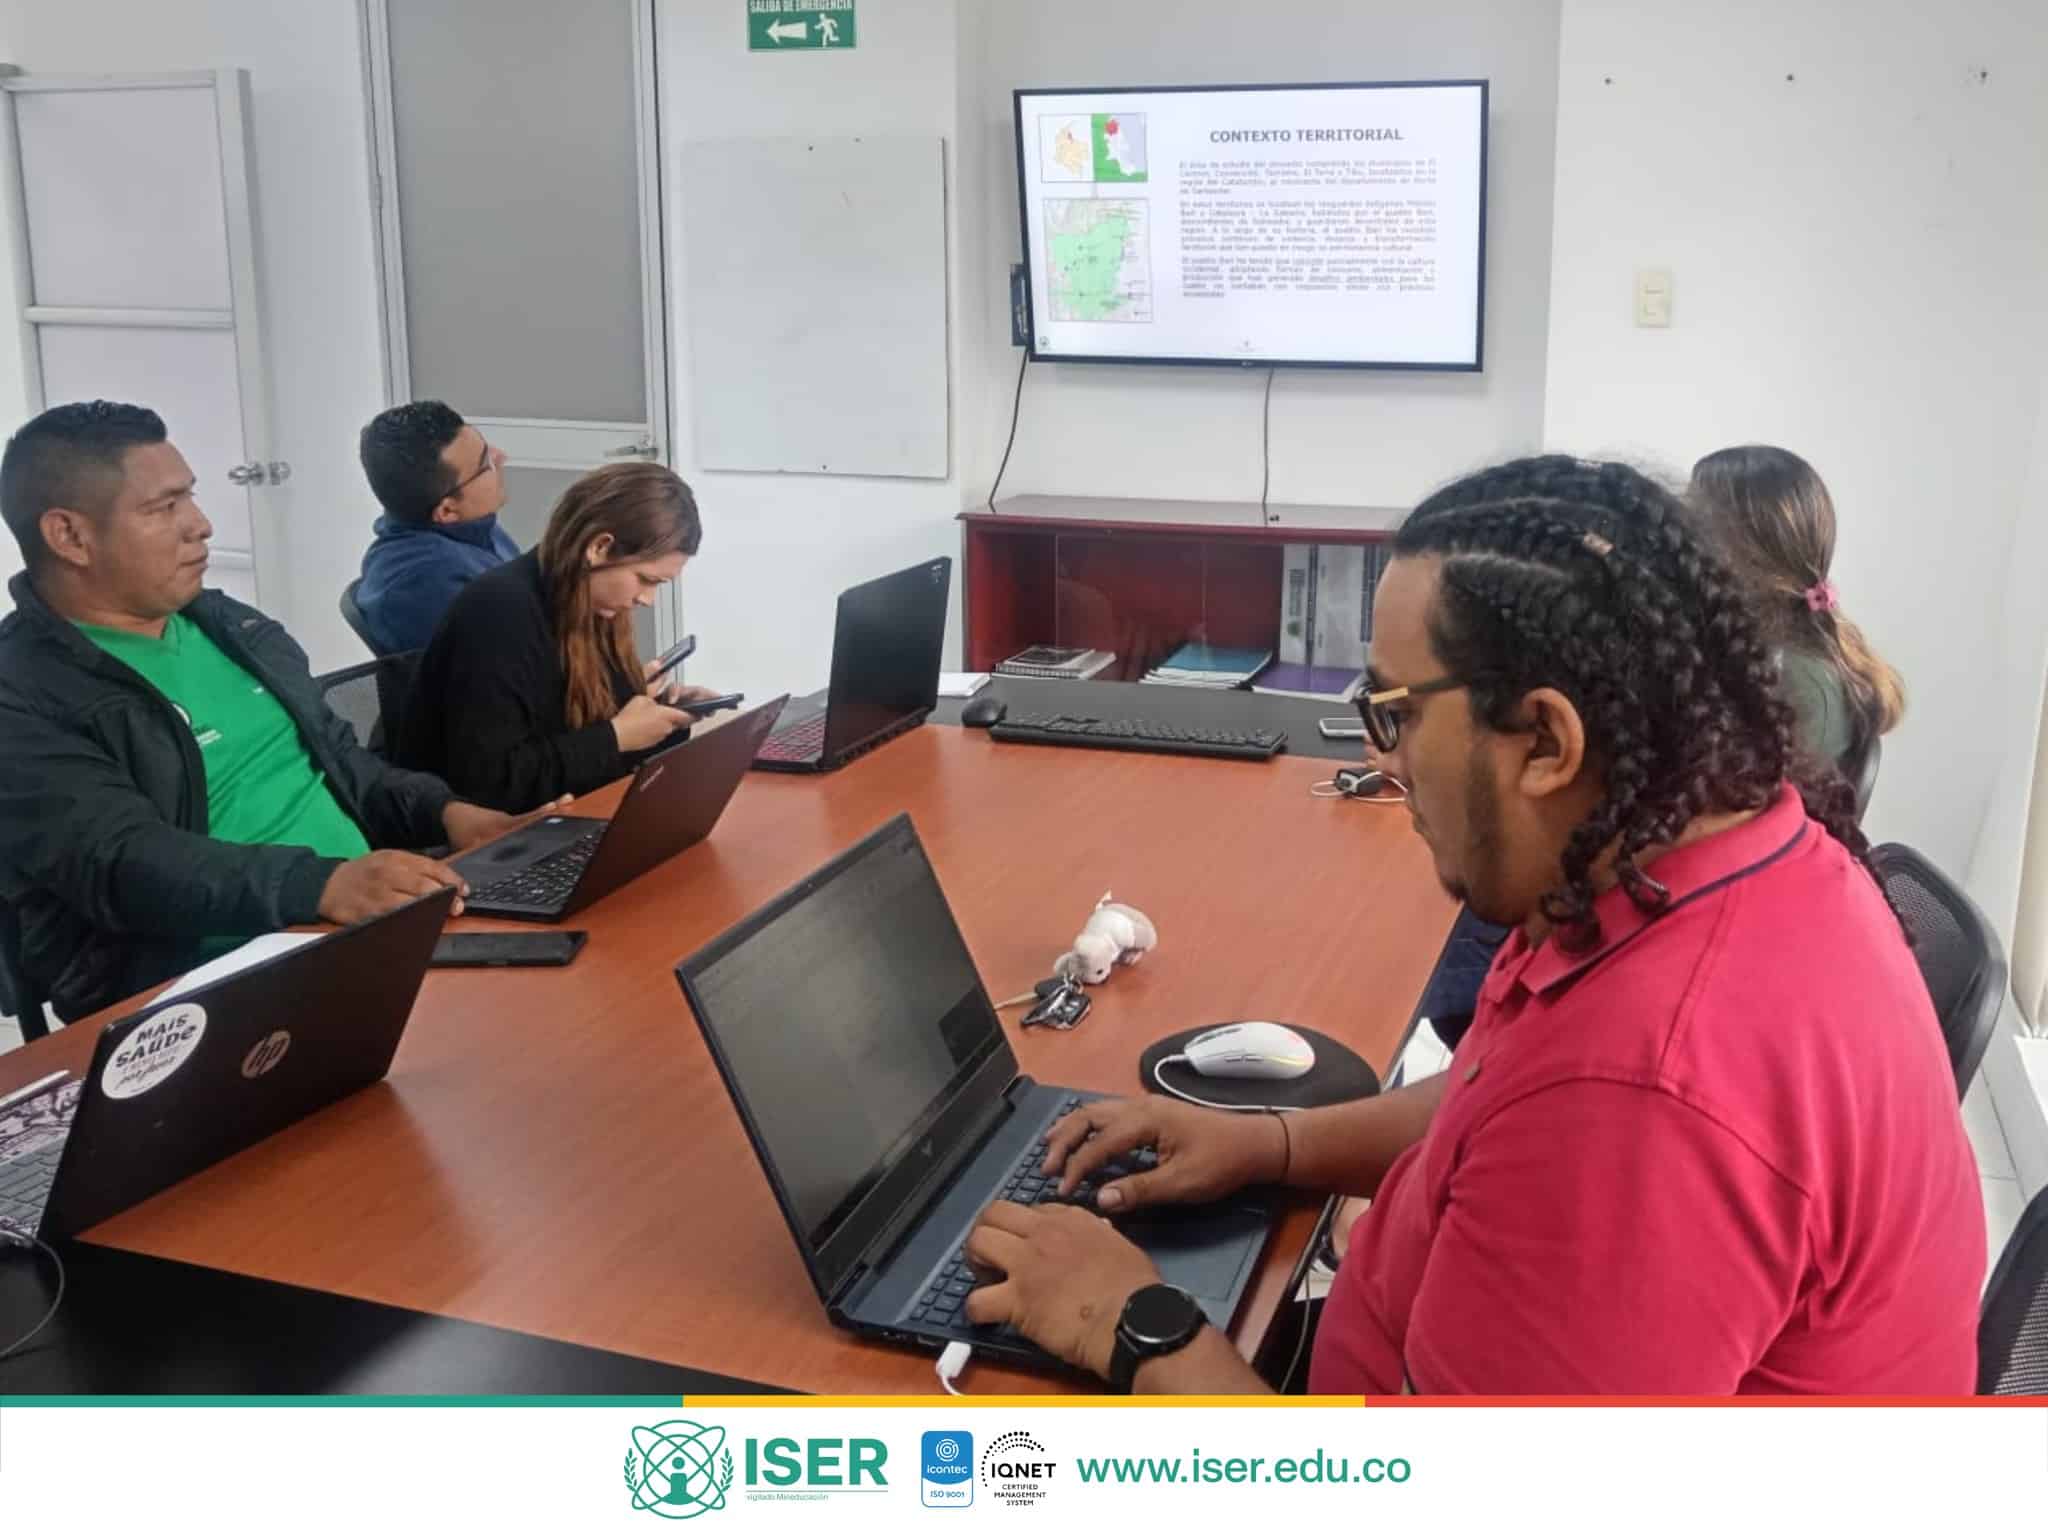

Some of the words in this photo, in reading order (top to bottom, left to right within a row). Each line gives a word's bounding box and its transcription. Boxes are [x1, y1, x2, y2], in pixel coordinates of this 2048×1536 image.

[1209, 130, 1291, 143] CONTEXTO
[1296, 128, 1404, 142] TERRITORIAL
[242, 1031, 291, 1078] hp
